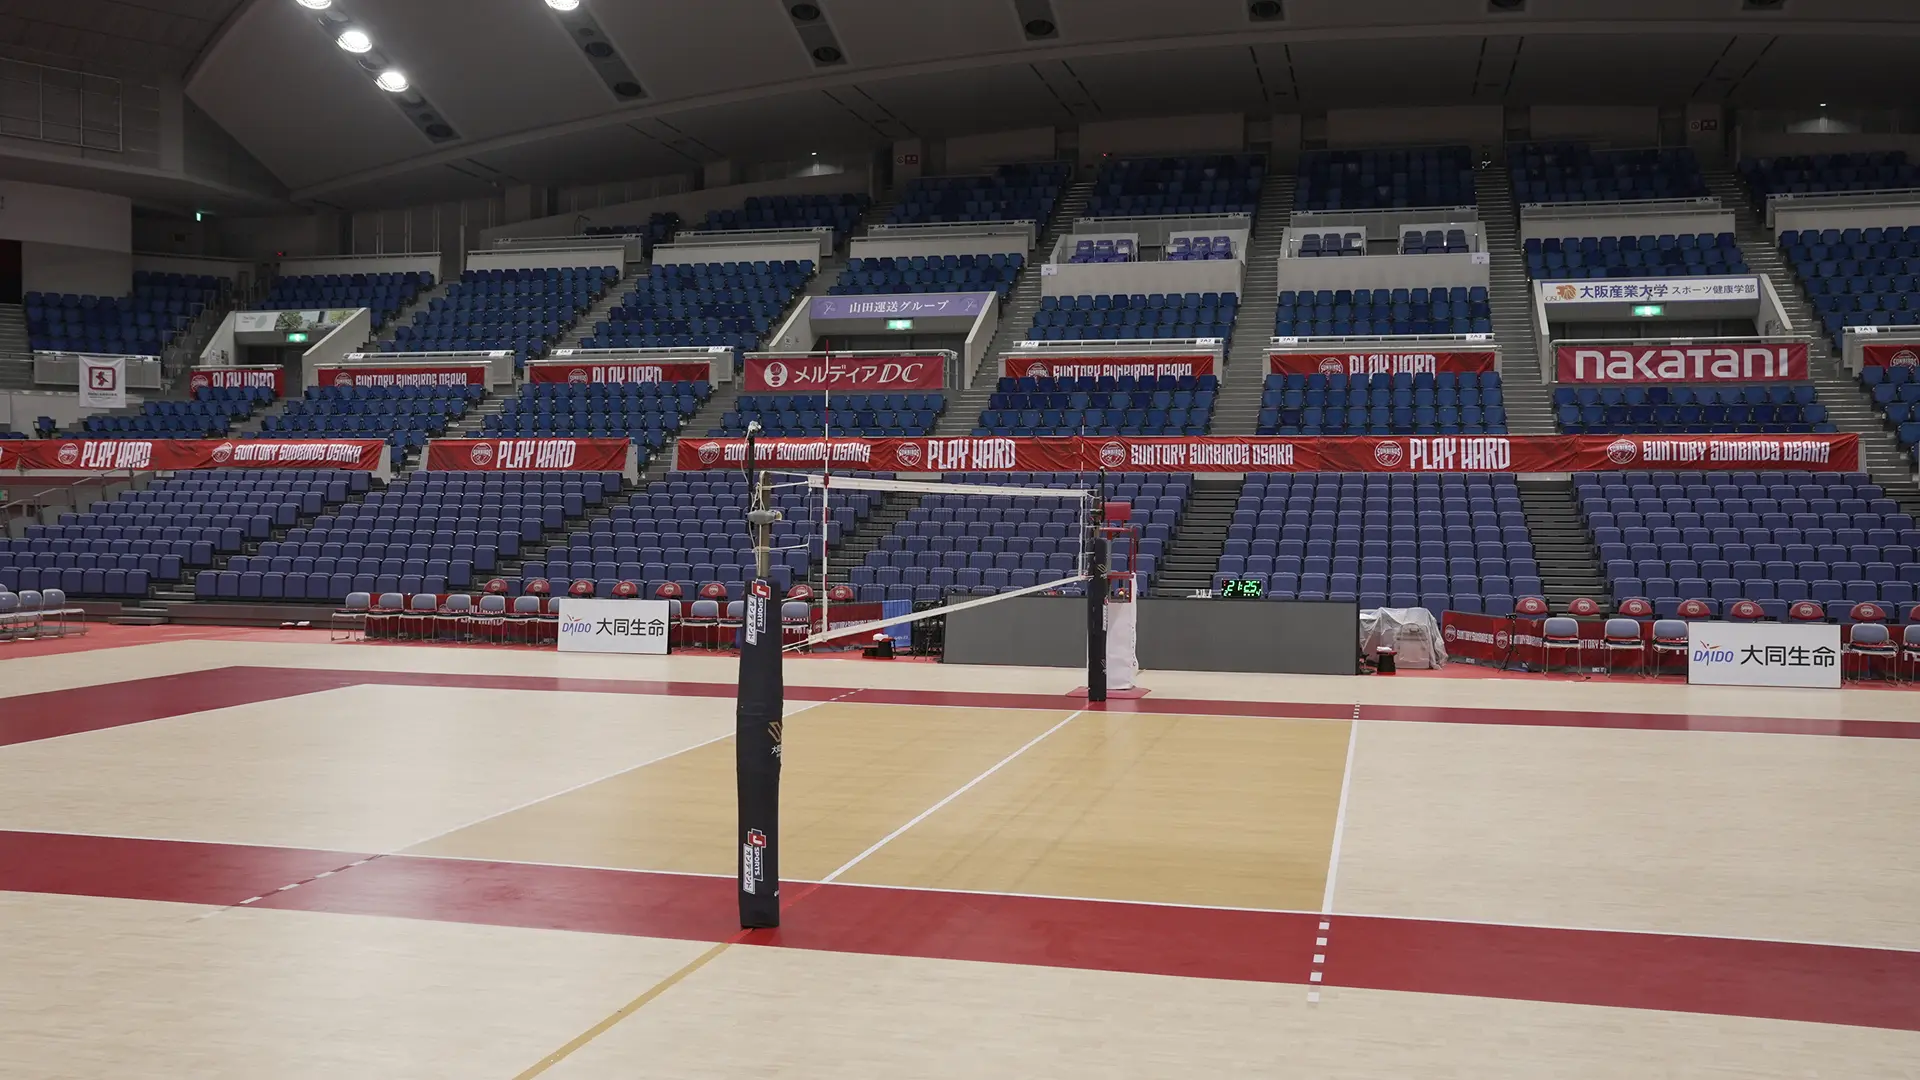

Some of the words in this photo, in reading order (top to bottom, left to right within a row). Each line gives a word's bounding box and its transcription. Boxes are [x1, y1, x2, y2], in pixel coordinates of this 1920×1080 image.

[1579, 283, 1669, 299] 大阪産業大学
[1671, 284, 1756, 296] スポーツ健康学部
[849, 299, 950, 314] 山田運送グループ
[80, 441, 116, 467] PLAY
[115, 441, 152, 468] HARD
[234, 444, 279, 461] SUNTORY
[279, 444, 329, 461] SUNBIRDS
[326, 445, 362, 463] OSAKA
[496, 440, 535, 468] PLAY
[536, 440, 576, 468] HARD
[776, 442, 830, 460] SUNBIRDS
[832, 442, 871, 463] OSAKA
[927, 439, 969, 469] PLAY
[972, 439, 1016, 469] HARD
[1131, 444, 1187, 465] SUNTORY
[1189, 444, 1250, 465] SUNBIRDS
[1252, 444, 1293, 465] OSAKA
[1409, 438, 1456, 469] PLAY
[1461, 438, 1510, 469] HARD
[1643, 440, 1707, 461] SUNTORY
[1710, 440, 1779, 462] SUNBIRDS
[1783, 441, 1830, 463] OSAKA
[562, 622, 591, 636] DAIDO
[596, 617, 665, 637] 大同生命
[1693, 650, 1733, 666] DAIDO
[1740, 644, 1836, 667] 大同生命
